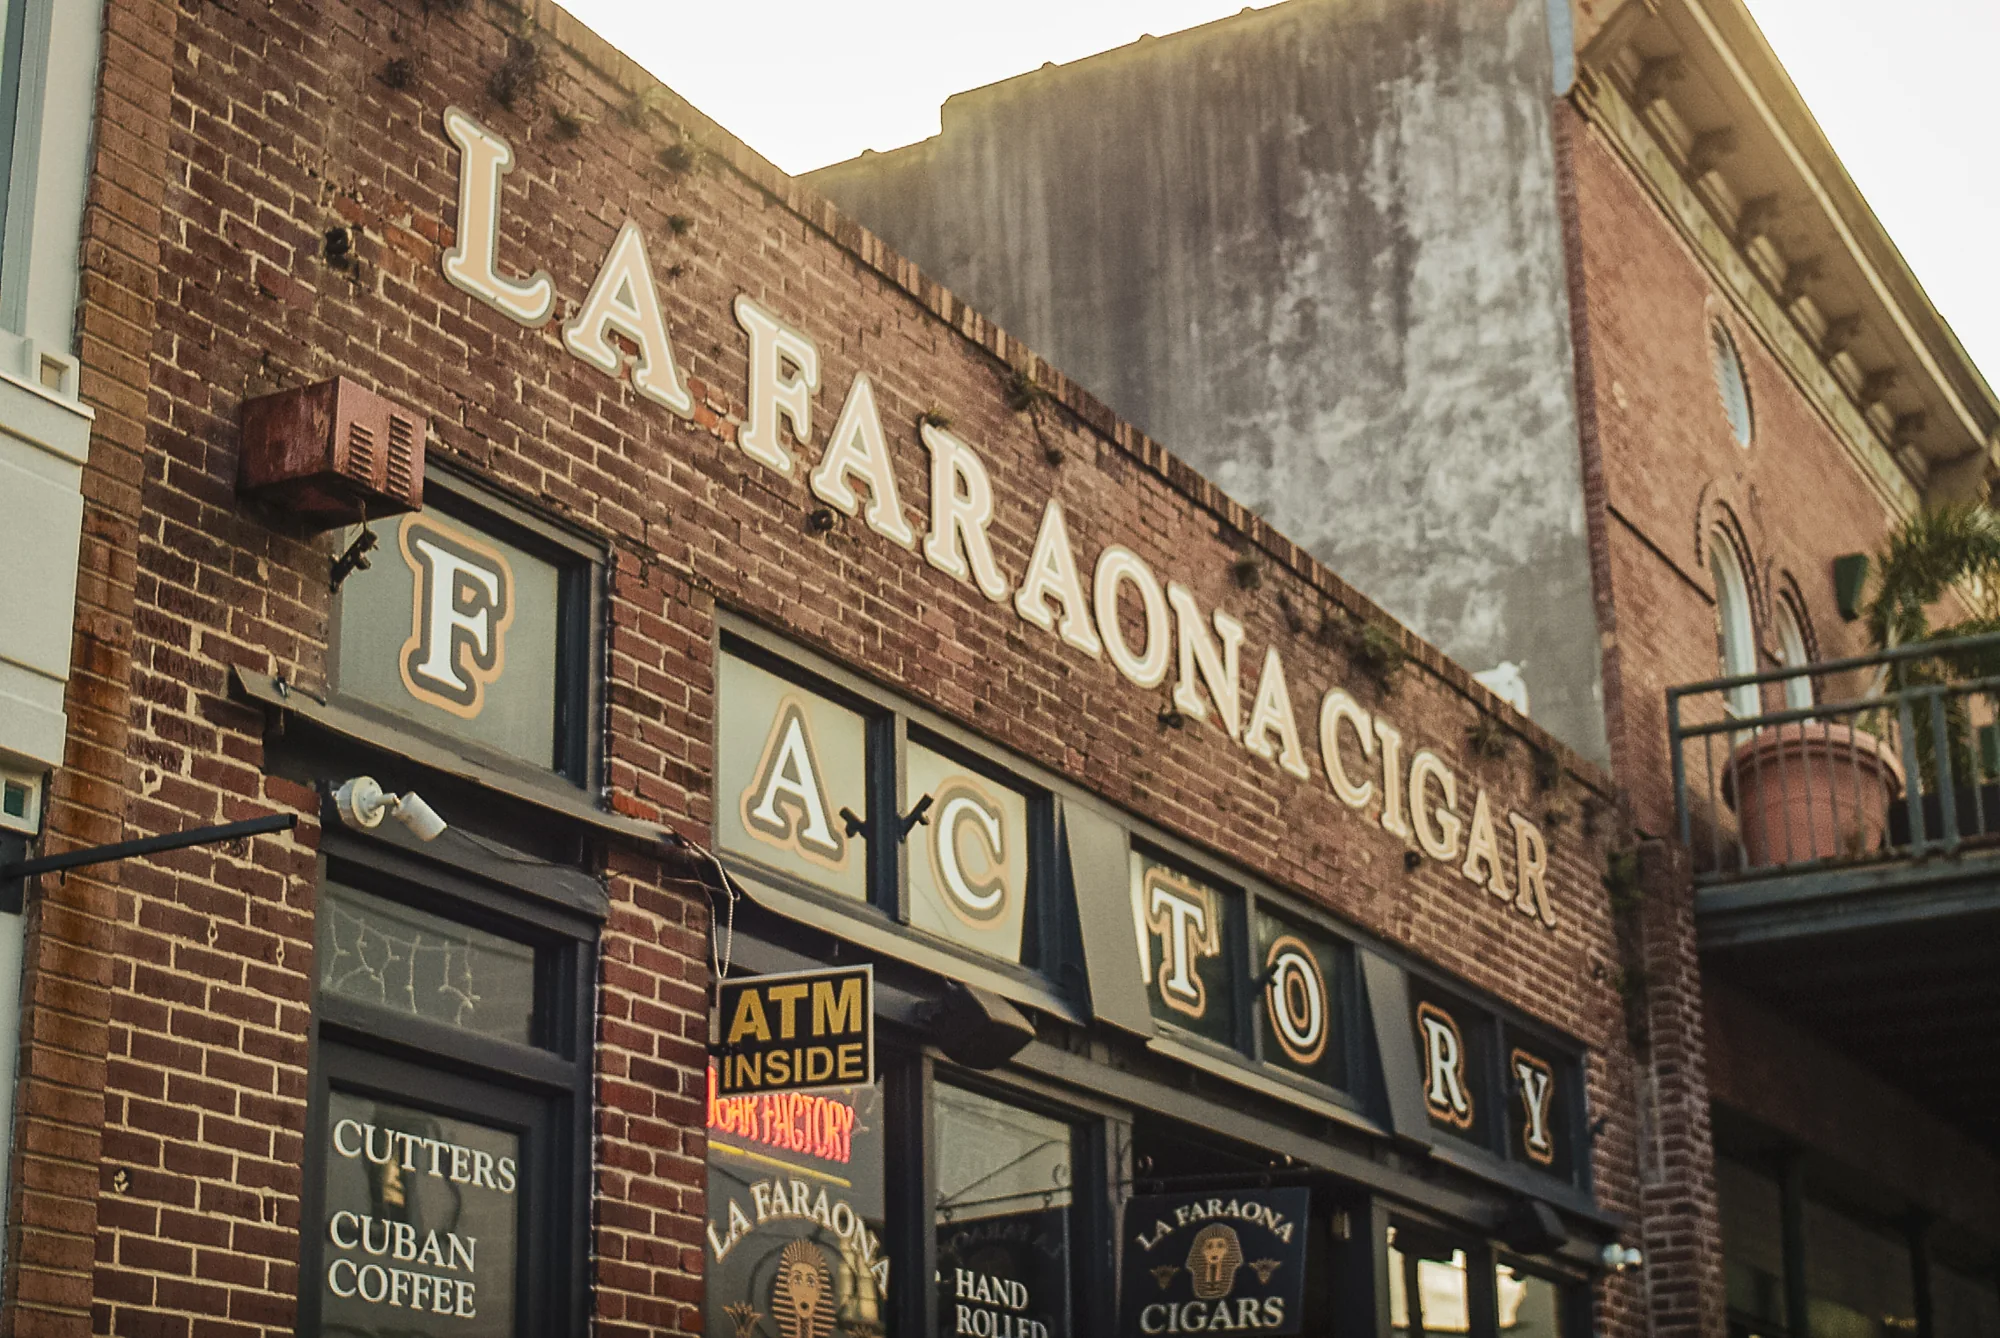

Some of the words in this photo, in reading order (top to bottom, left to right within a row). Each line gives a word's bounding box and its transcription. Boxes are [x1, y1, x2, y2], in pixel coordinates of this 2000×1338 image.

[443, 105, 695, 420] LA
[734, 293, 1311, 780] FARAONA
[1319, 687, 1557, 930] CIGAR
[400, 511, 1554, 1165] FACTORY
[728, 977, 862, 1044] ATM
[724, 1043, 864, 1089] INSIDE
[706, 1067, 758, 1142] IGAR
[761, 1091, 854, 1165] FACTORY
[332, 1118, 518, 1193] CUTTERS
[330, 1210, 477, 1273] CUBAN
[706, 1199, 753, 1264] LA
[750, 1177, 891, 1296] FARAONA
[1135, 1220, 1174, 1251] LA
[1174, 1198, 1294, 1243] FARAONA
[328, 1258, 477, 1320] COFFEE
[955, 1267, 1029, 1311] HAND
[1140, 1296, 1285, 1334] CIGARS
